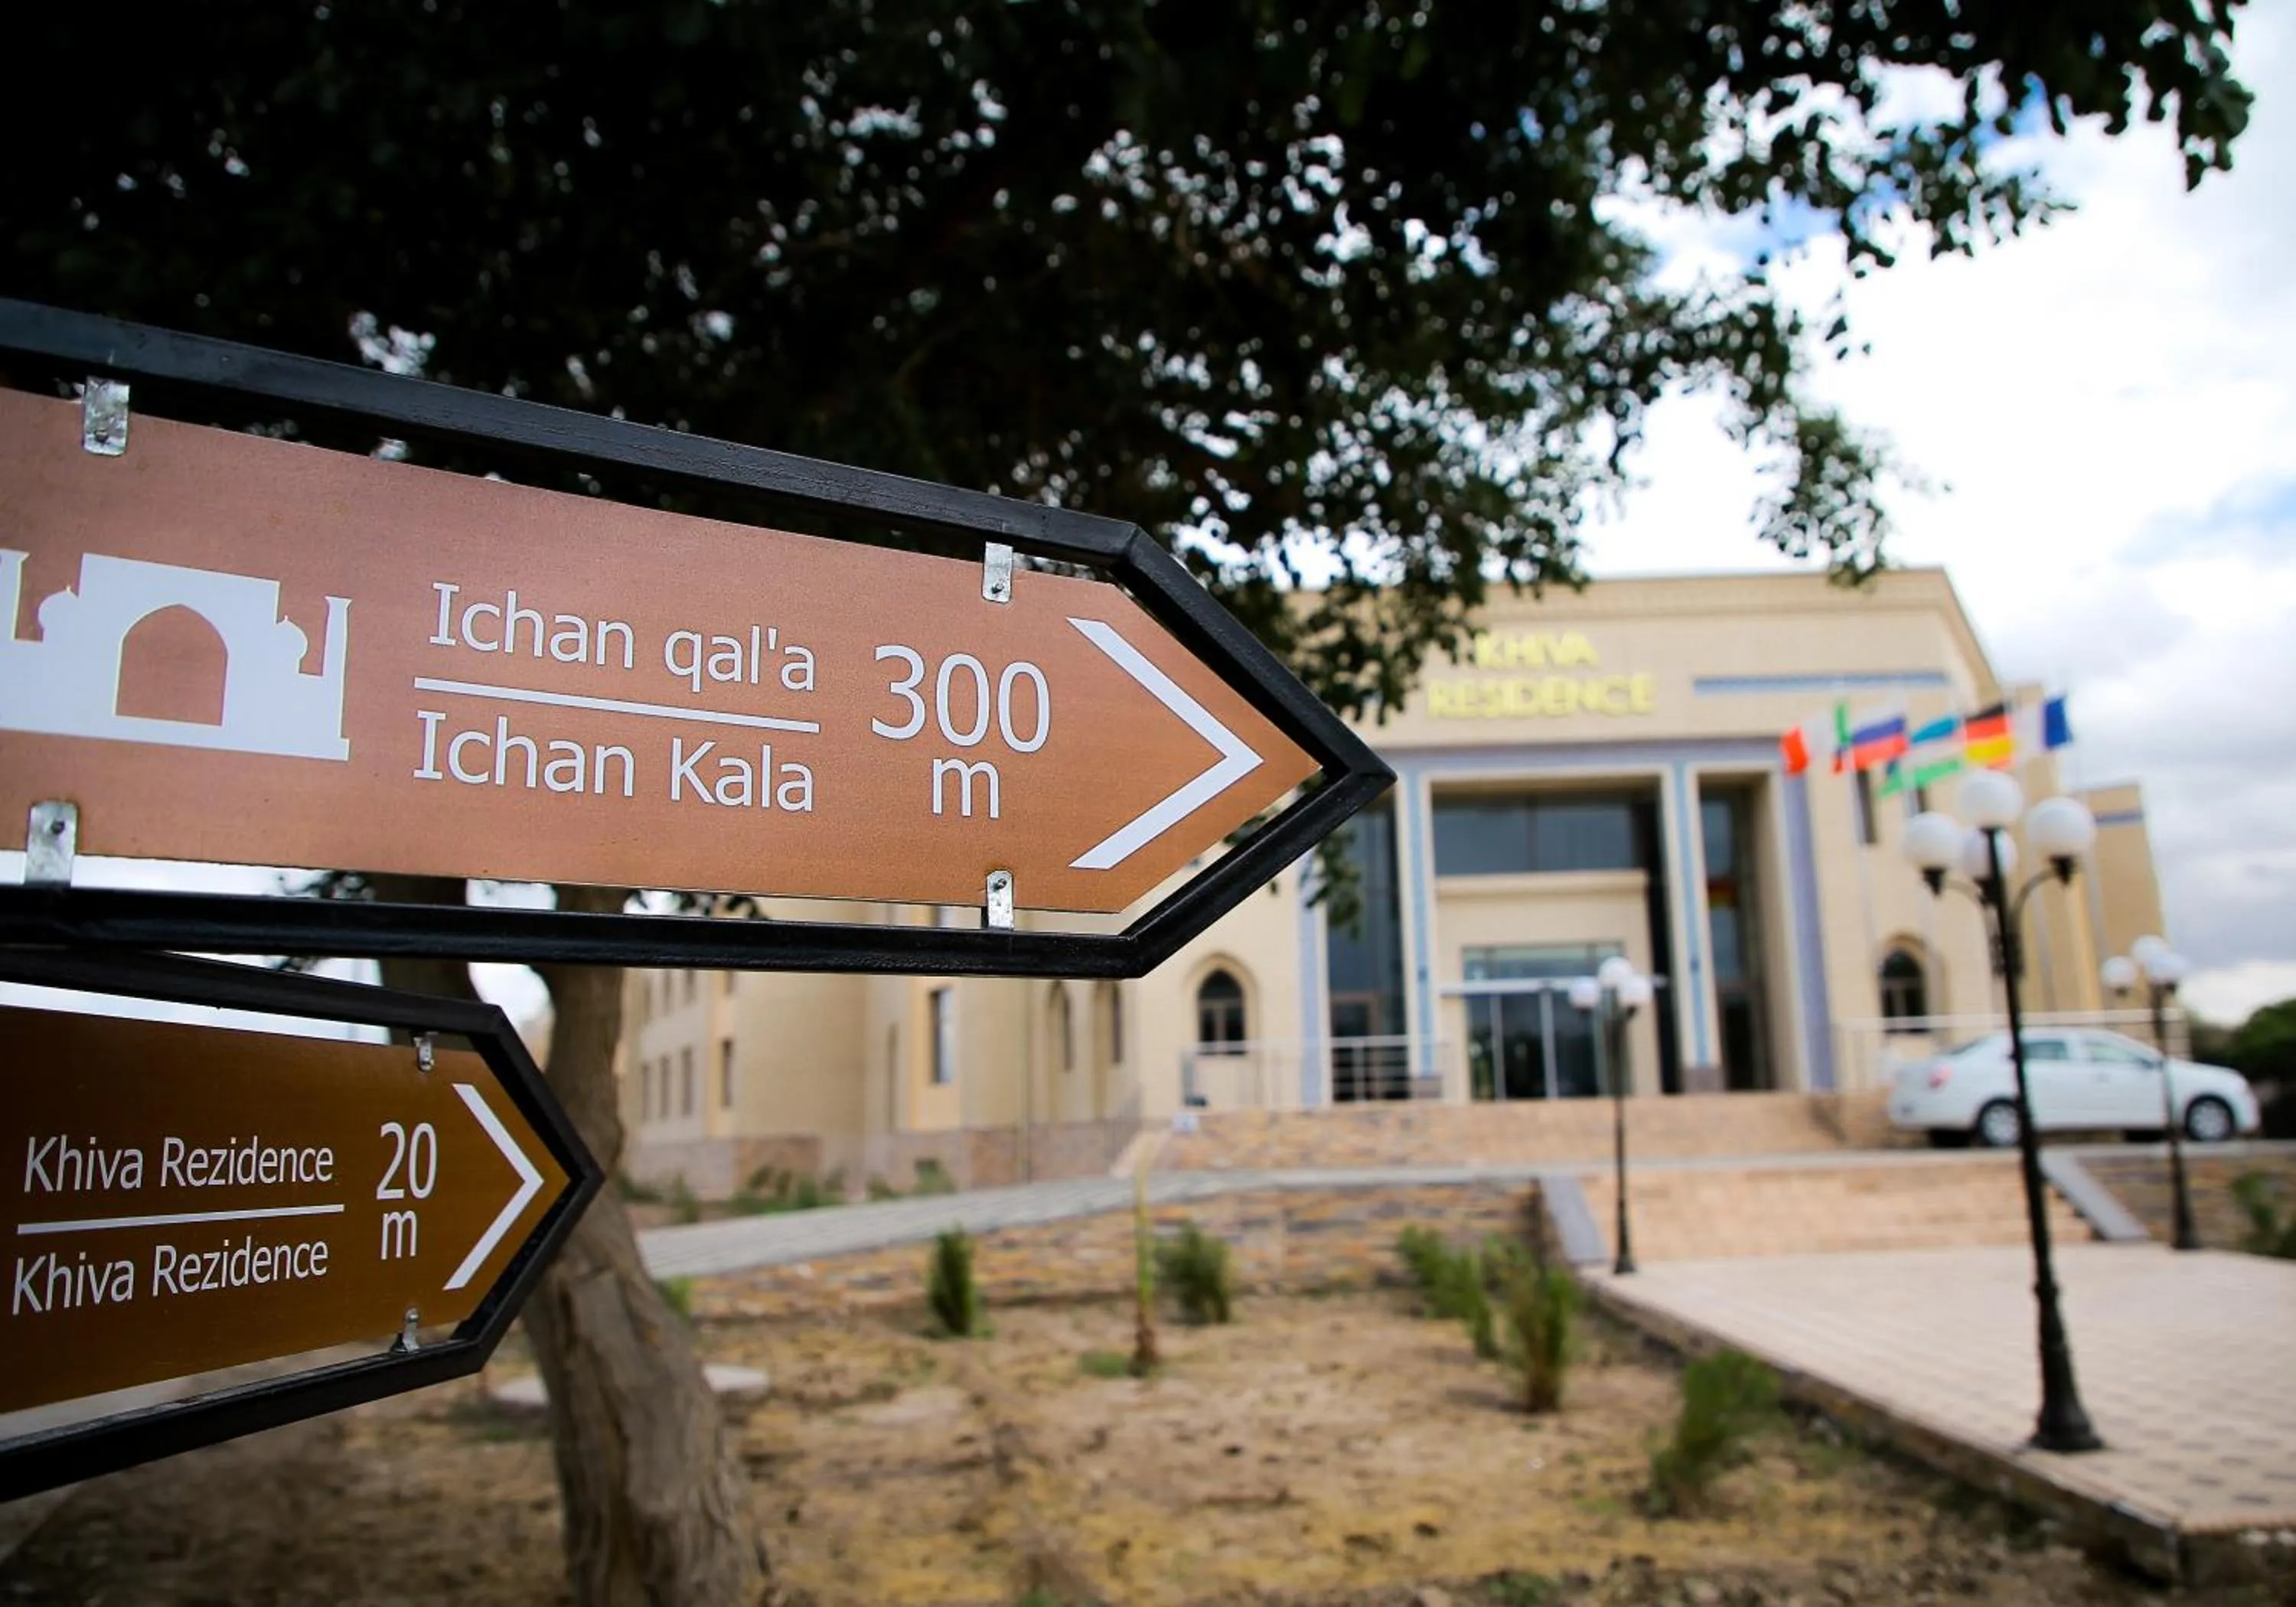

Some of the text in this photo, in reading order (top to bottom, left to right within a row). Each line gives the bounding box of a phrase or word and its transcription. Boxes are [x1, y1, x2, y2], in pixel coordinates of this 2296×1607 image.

[429, 582, 815, 693] Ichan qal'a
[871, 644, 1051, 753] 300
[1427, 672, 1655, 719] RESIDENCE
[413, 709, 814, 813] Ichan Kala
[932, 758, 1000, 819] m
[24, 1134, 334, 1193] Khiva Rezidence
[375, 1121, 438, 1201] 20
[380, 1209, 418, 1261] m
[12, 1235, 329, 1316] Khiva Rezidence
